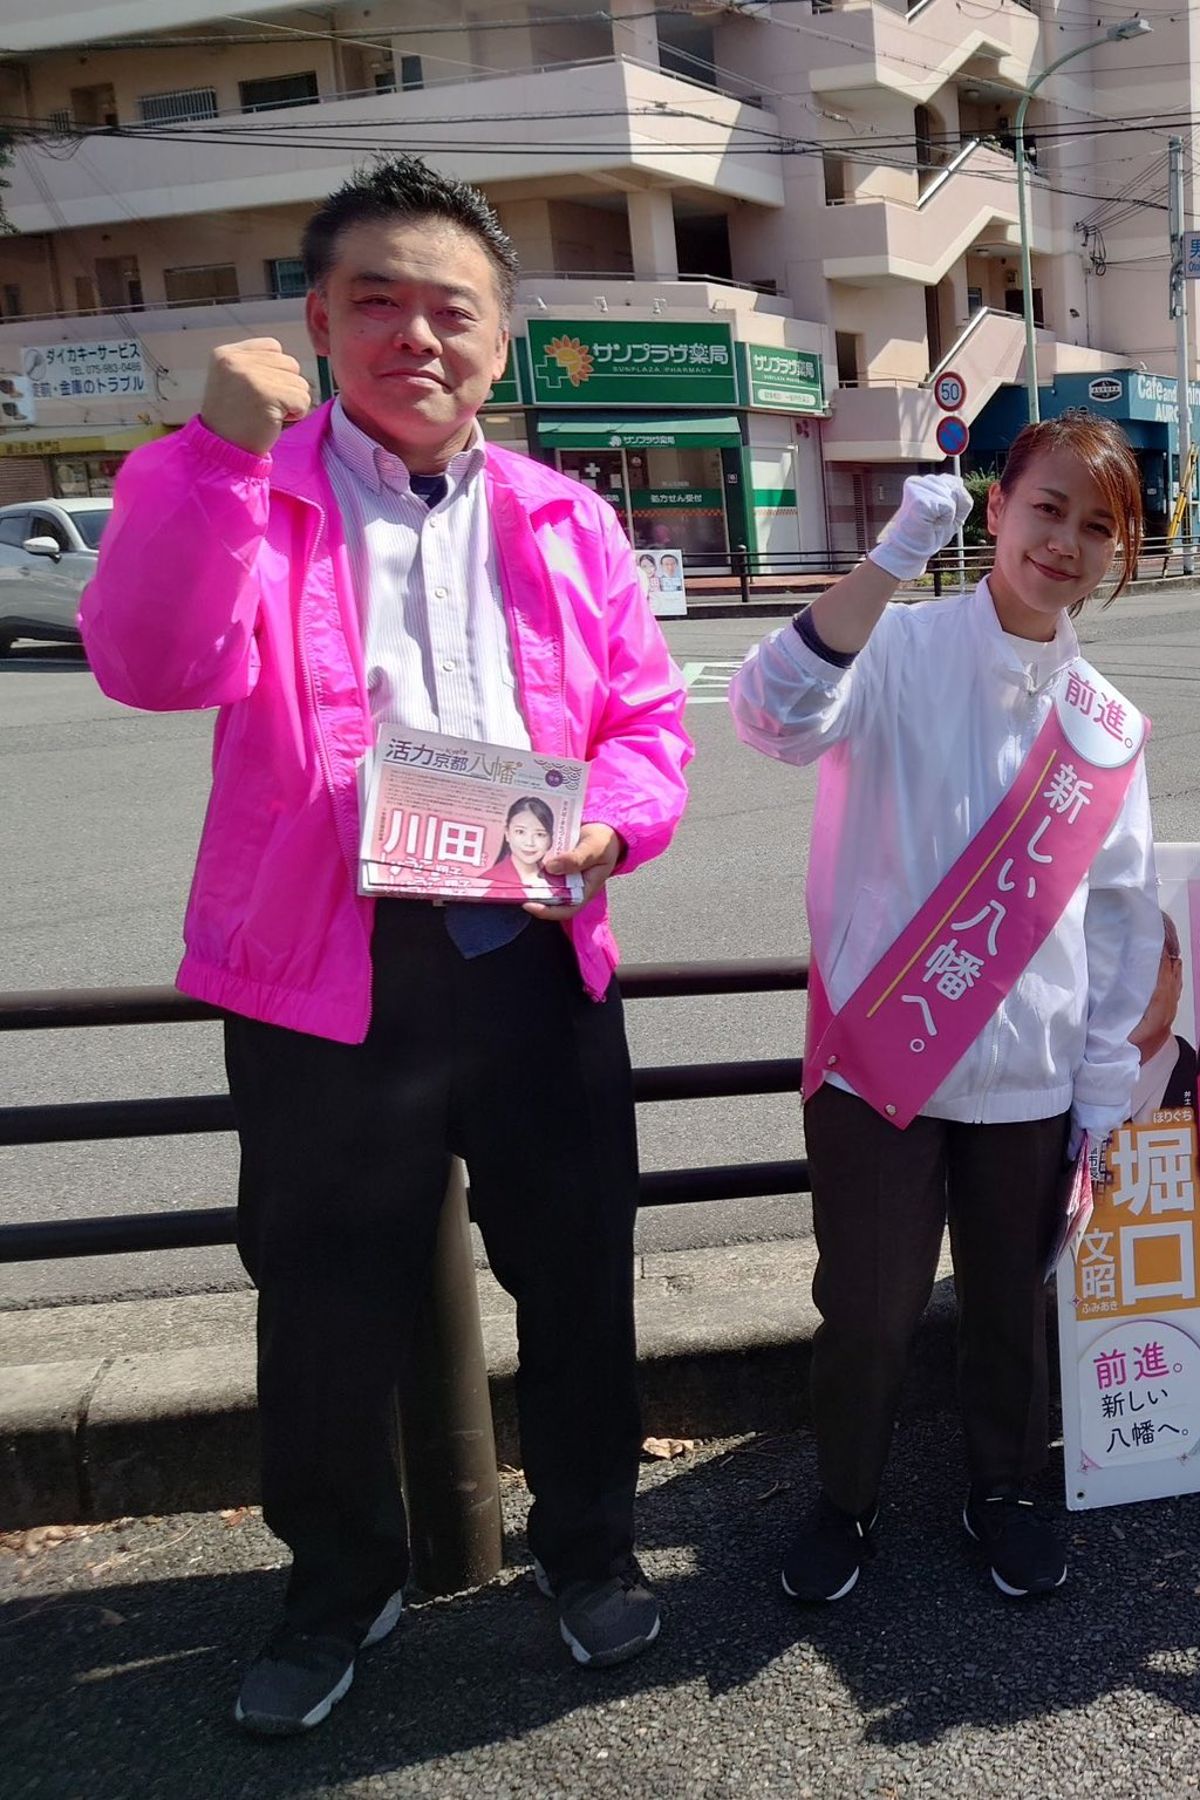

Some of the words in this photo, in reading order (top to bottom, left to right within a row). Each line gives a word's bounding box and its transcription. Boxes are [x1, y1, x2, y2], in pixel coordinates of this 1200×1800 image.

[46, 343, 140, 365] ダイカキーサービス
[592, 343, 729, 365] サンプラザ薬局
[941, 382, 960, 400] 50
[1138, 374, 1163, 400] Cafe
[1163, 385, 1177, 402] and
[1064, 671, 1134, 750] 前進。
[383, 808, 486, 867] 川田
[901, 763, 1094, 1054] 新しい八幡へ。
[1153, 1110, 1192, 1123] ほりぐち
[1111, 1128, 1196, 1306] 堀口
[1079, 1227, 1115, 1300] 文昭
[1082, 1302, 1119, 1314] ふみあき
[1093, 1341, 1183, 1390] 前進。
[1101, 1386, 1169, 1419] 新しい
[1106, 1420, 1189, 1453] 八幡へ。
